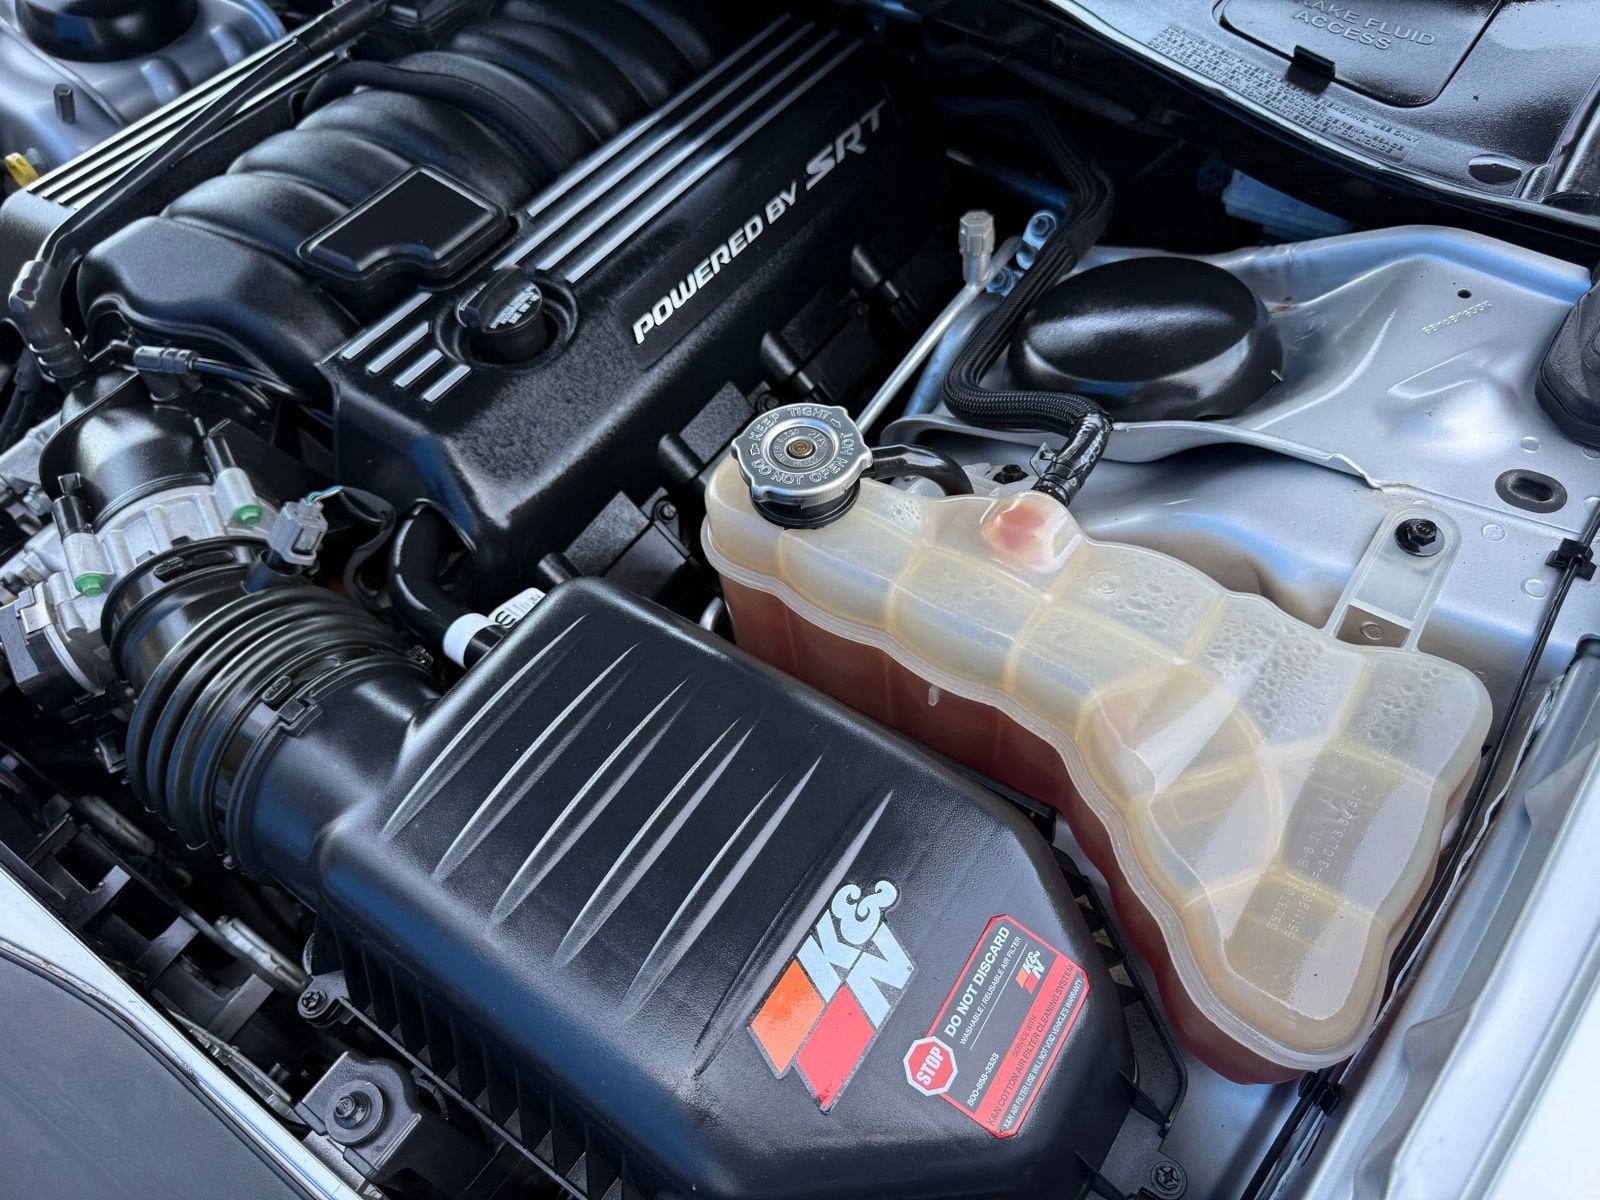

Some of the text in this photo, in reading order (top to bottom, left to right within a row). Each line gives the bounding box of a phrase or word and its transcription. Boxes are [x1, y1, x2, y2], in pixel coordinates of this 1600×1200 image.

[1293, 10, 1392, 50] ACCESS
[1364, 17, 1435, 46] FLUID
[632, 214, 764, 345] POWERED
[765, 179, 797, 225] BY
[805, 99, 886, 191] SRT
[748, 413, 780, 441] KEEP
[751, 458, 772, 476] DO
[771, 471, 804, 485] NOT
[809, 456, 849, 482] OPEN
[797, 880, 914, 1029] K&N
[943, 925, 1011, 1038] DO NOT DISCARD
[958, 1005, 984, 1045] WASHABLE
[980, 967, 1004, 1004] REUSABLE
[999, 956, 1011, 970] AIR
[1005, 935, 1022, 958] FILTER
[915, 1045, 946, 1086] STOP
[986, 963, 1075, 1126] K&N COTTON AIR FILTER CLEANING SYSTEM
[1002, 1113, 1014, 1129] K&N
[1008, 1102, 1020, 1115] AIR
[1014, 1084, 1029, 1104] FILTER
[1024, 1072, 1035, 1086] USE
[1030, 1058, 1042, 1074] WILL
[1037, 1046, 1049, 1061] NOT
[1043, 1032, 1056, 1048] VOID
[1063, 977, 1084, 1008] WARRANTY
[1011, 1014, 1037, 1058] SERVICE WITH
